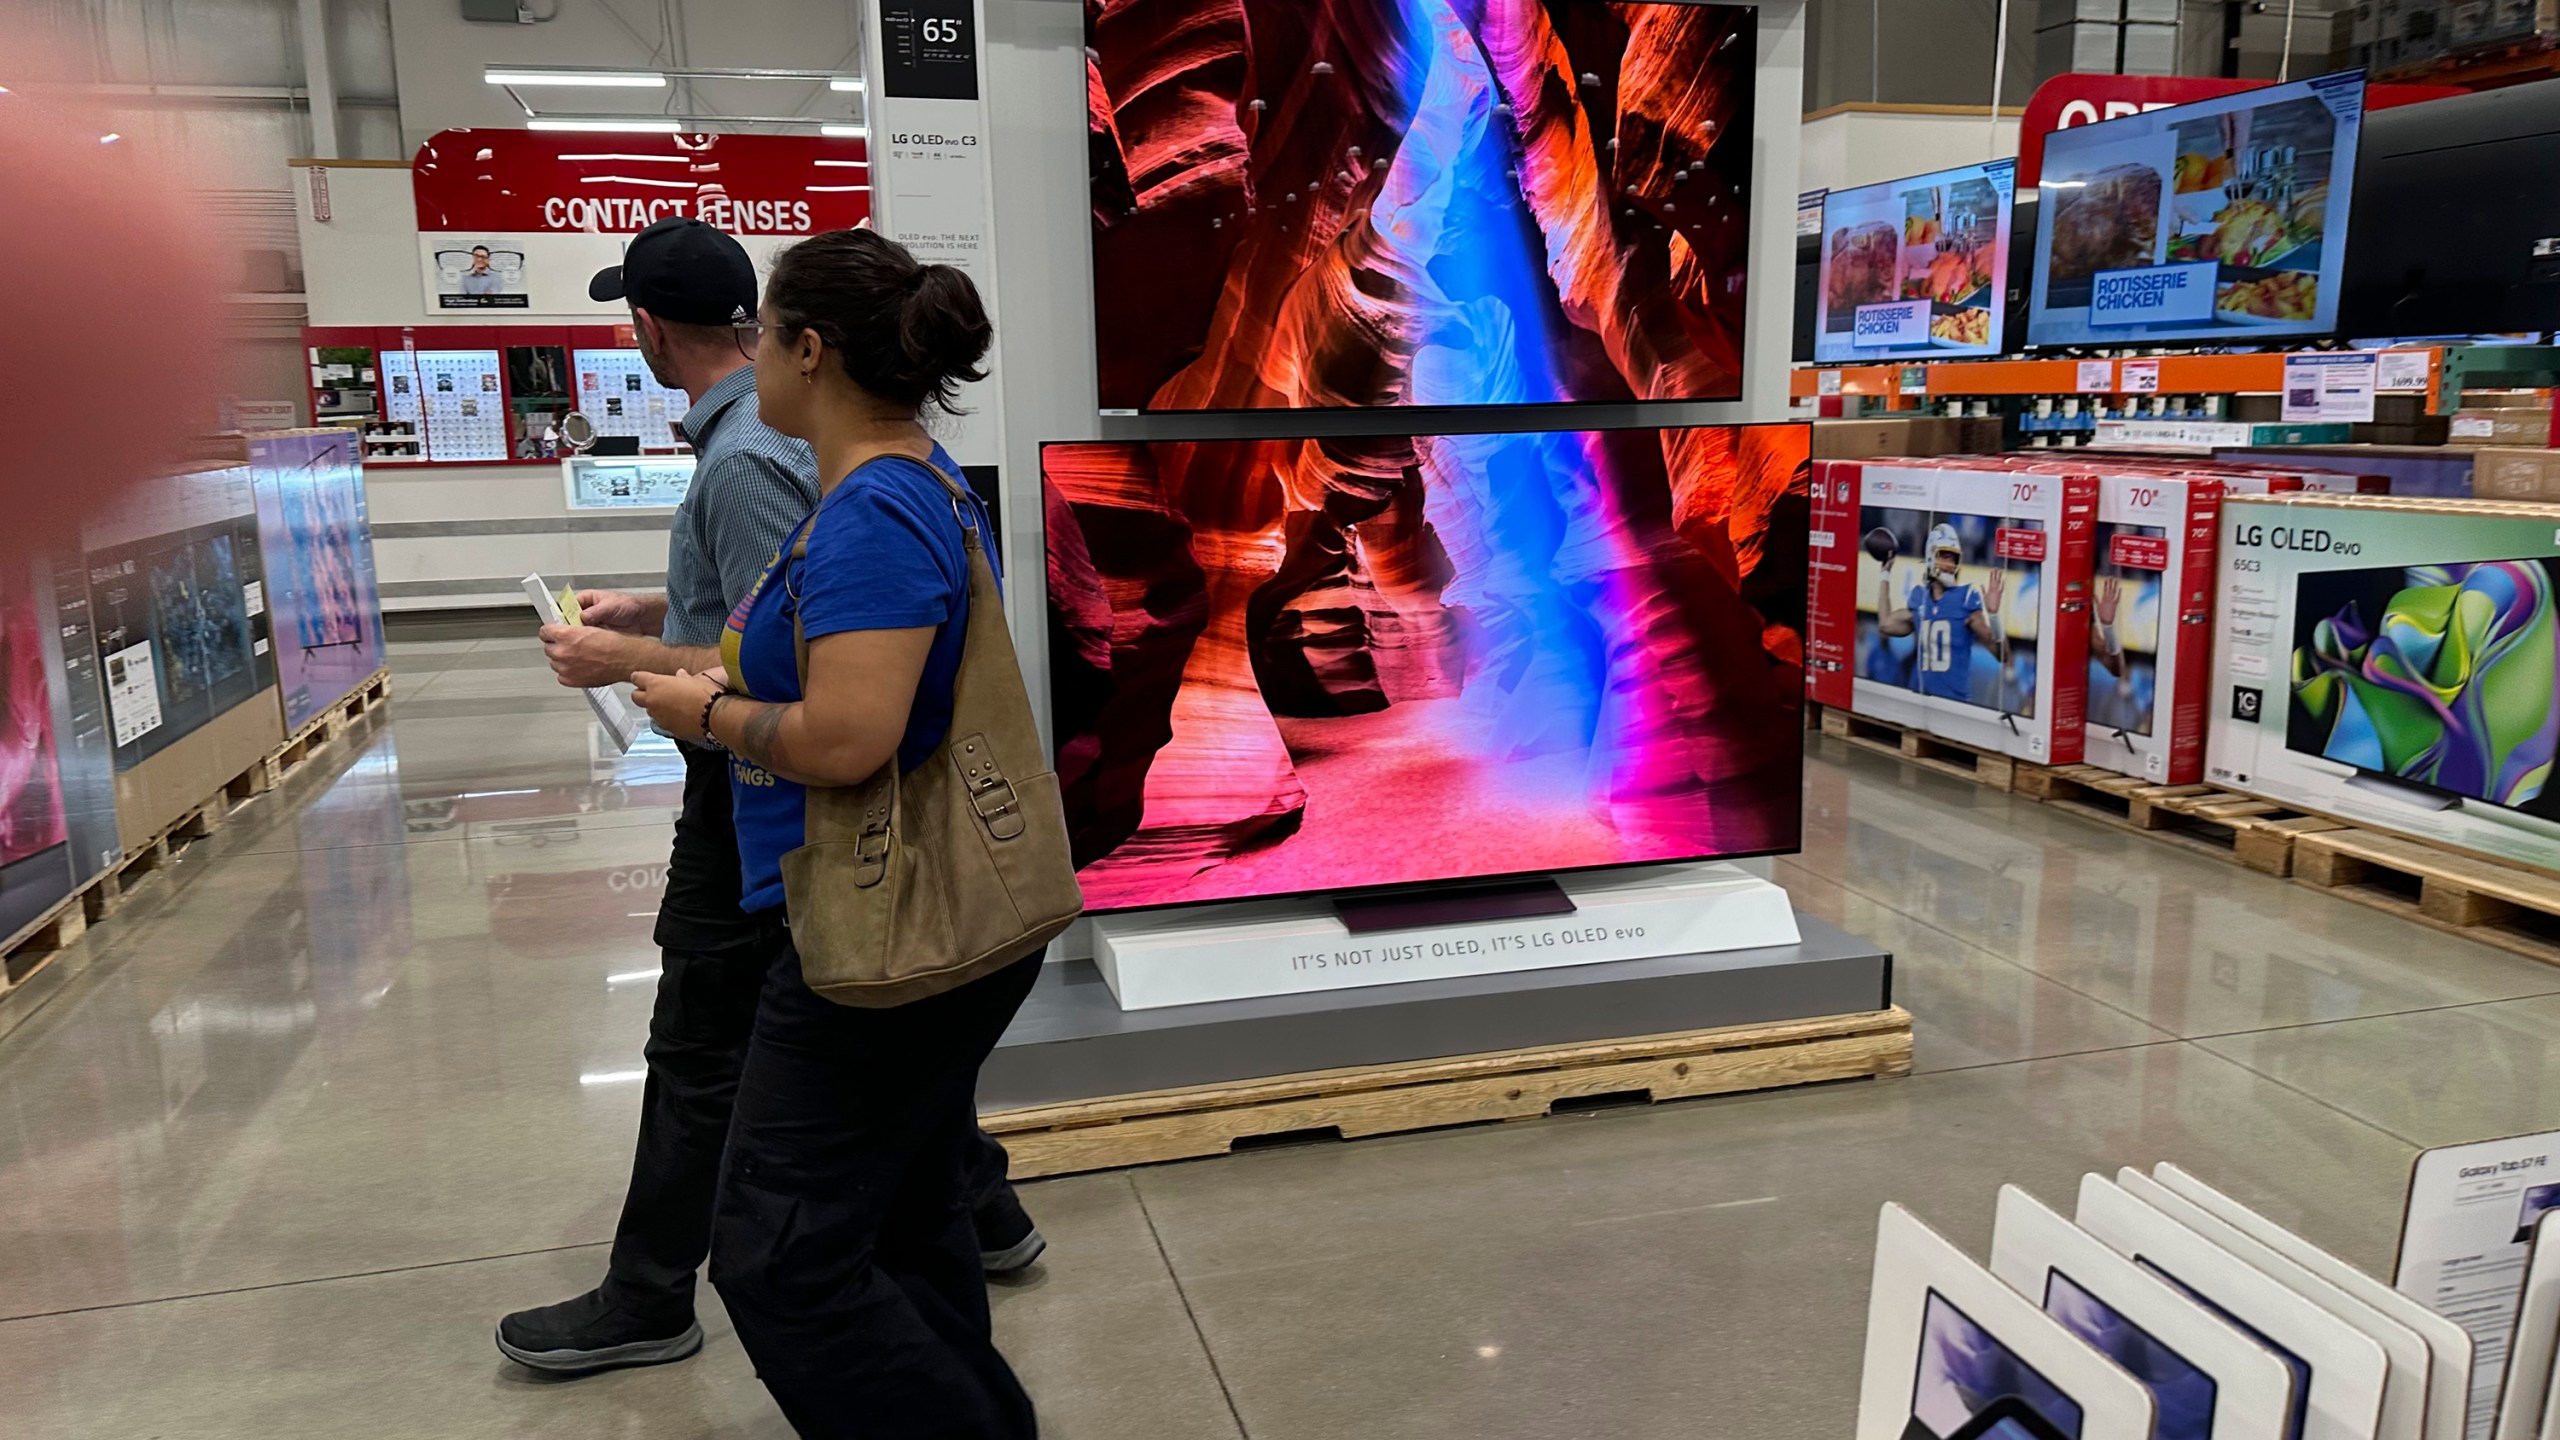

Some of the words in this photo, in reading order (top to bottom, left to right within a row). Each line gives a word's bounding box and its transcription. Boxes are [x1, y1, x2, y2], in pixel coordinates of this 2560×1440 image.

[923, 18, 962, 42] 65"
[892, 133, 908, 144] LG
[911, 134, 944, 145] OLED
[945, 138, 959, 146] evo
[961, 135, 977, 146] C3
[544, 197, 688, 229] CONTACT
[898, 233, 920, 241] OLED
[941, 233, 956, 241] THE
[958, 234, 980, 242] NEXT
[947, 242, 955, 250] IS
[2098, 272, 2188, 294] ROTISSERIE
[2096, 290, 2164, 311] CHICKEN
[1857, 306, 1914, 323] ROTISSERIE
[1857, 321, 1899, 336] CHICKEN
[1810, 482, 1828, 499] CL
[2013, 483, 2038, 501] 70"
[2130, 487, 2159, 508] 70"
[2235, 524, 2263, 547] LG
[2271, 526, 2332, 553] OLED
[2333, 540, 2362, 556] evo
[2233, 558, 2262, 572] 65C3
[1920, 619, 1951, 673] 10
[1292, 954, 1328, 971] IT'S
[1335, 949, 1373, 968] NOT
[1381, 944, 1424, 963] JUST
[1431, 939, 1487, 959] OLED,
[1491, 934, 1526, 952] IT'S
[1532, 932, 1556, 948] LG
[1561, 926, 1608, 945] OLED
[1614, 925, 1646, 940] evo
[2459, 1165, 2499, 1179] Galaxy
